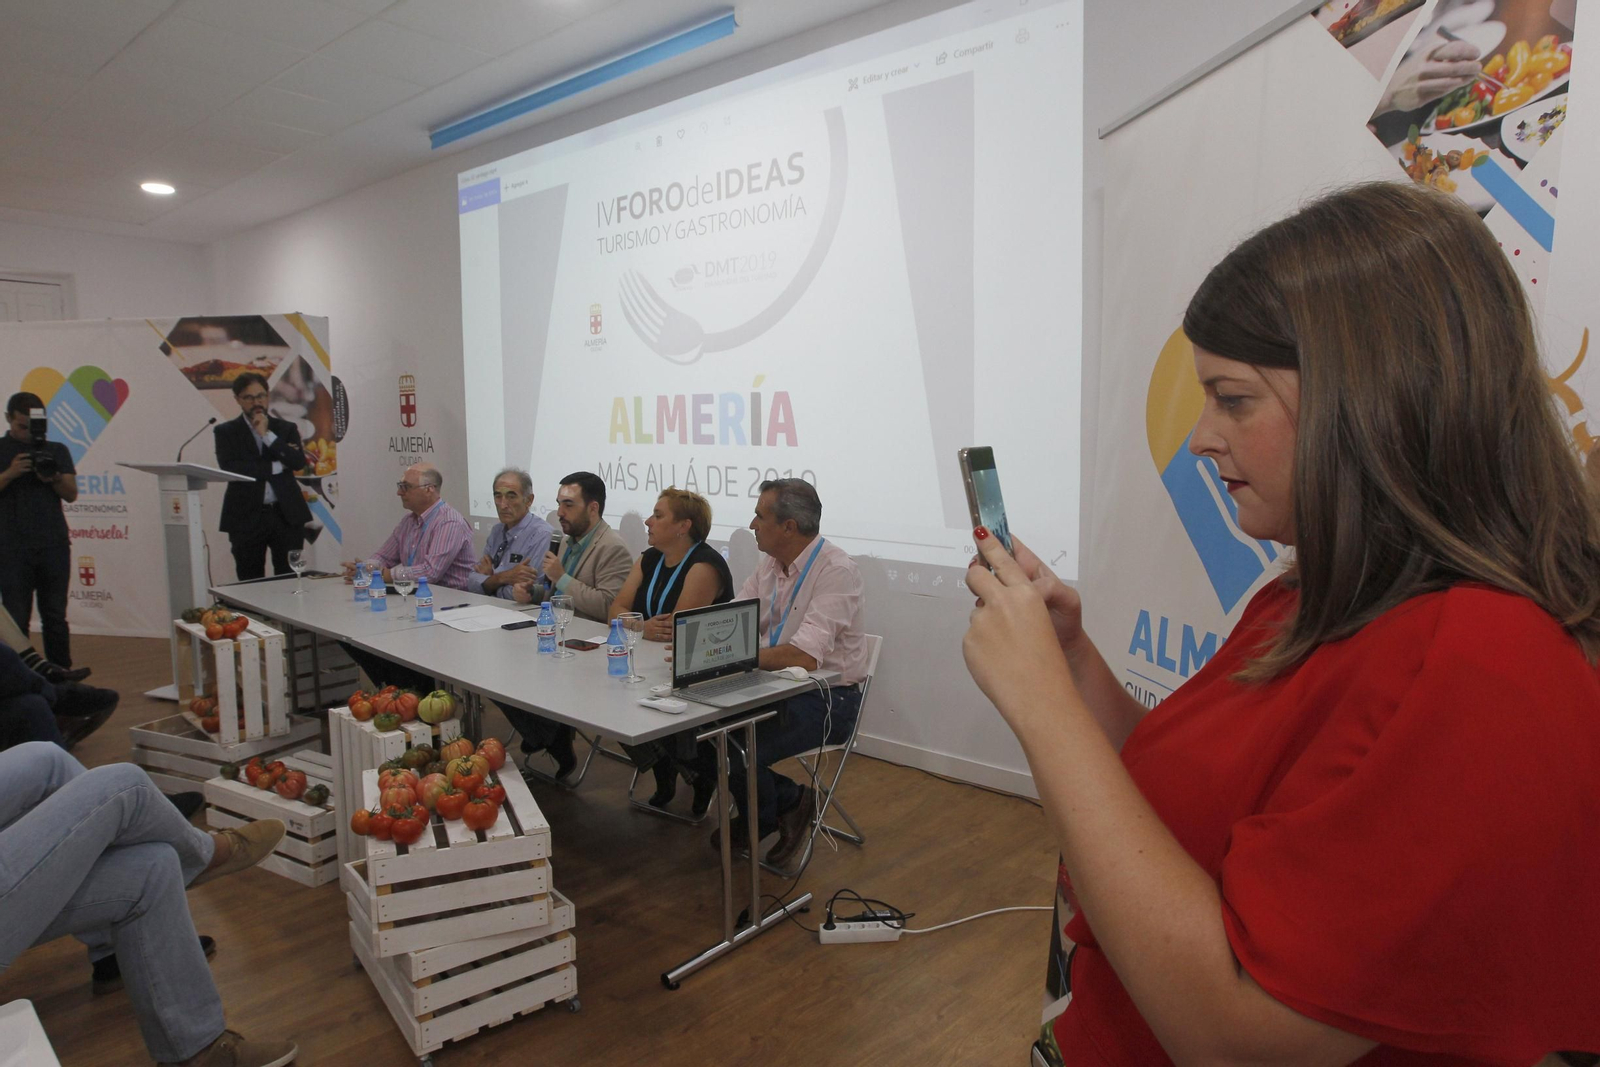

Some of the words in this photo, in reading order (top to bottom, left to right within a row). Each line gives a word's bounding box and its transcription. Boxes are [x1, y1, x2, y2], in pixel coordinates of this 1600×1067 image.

[953, 41, 994, 59] Compartir
[863, 73, 883, 85] Editar
[596, 225, 660, 255] TURISMO
[660, 223, 671, 242] Y
[675, 194, 807, 240] GASTRONOMÍA
[609, 374, 798, 447] ALMERÍA
[388, 432, 434, 453] ALMERÍA
[76, 471, 126, 495] ERÍA
[598, 456, 639, 491] MÁS
[707, 465, 739, 497] DE
[69, 589, 114, 601] ALMERÍA
[1128, 609, 1228, 679] ALM
[1125, 681, 1164, 709] IUD
